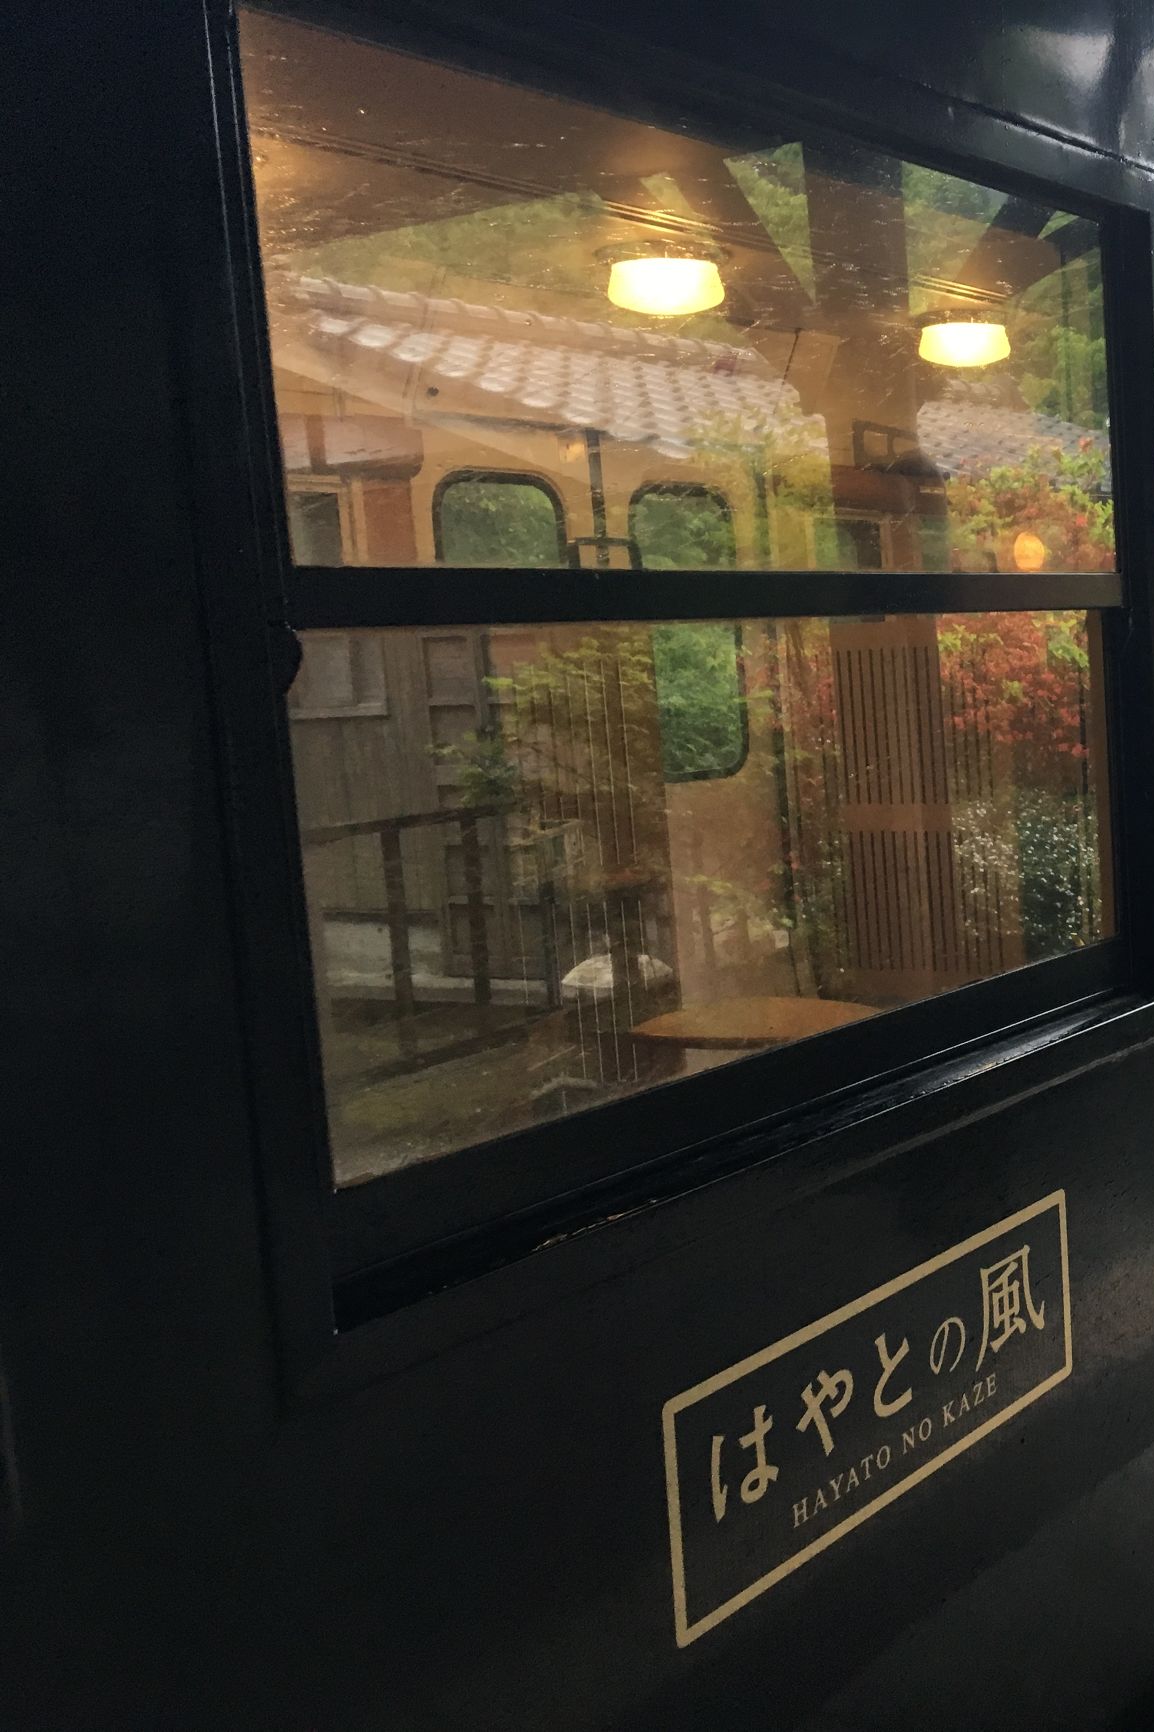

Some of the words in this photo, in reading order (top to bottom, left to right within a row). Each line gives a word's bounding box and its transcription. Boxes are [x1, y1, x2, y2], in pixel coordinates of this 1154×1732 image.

[709, 1244, 1046, 1524] はやとの風
[791, 1445, 892, 1529] HAYATO
[901, 1416, 933, 1455] NO
[941, 1373, 999, 1428] KAZE
